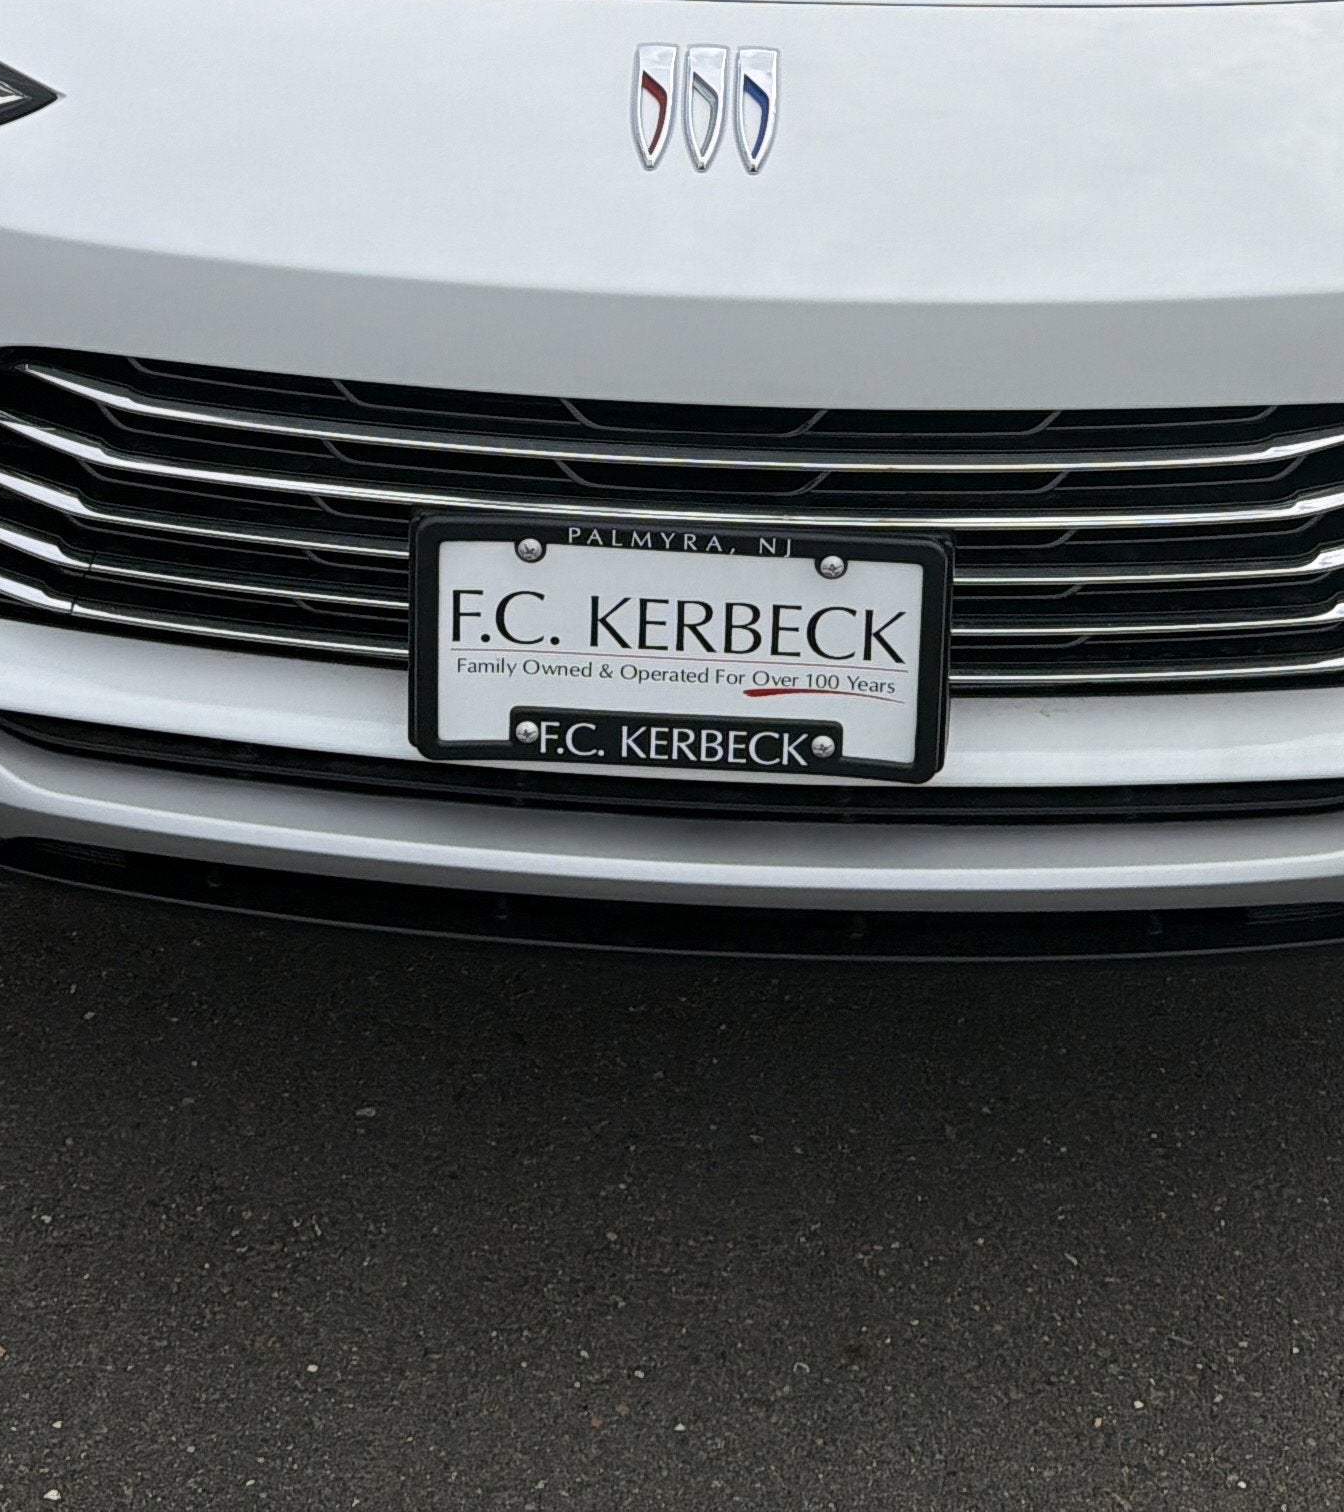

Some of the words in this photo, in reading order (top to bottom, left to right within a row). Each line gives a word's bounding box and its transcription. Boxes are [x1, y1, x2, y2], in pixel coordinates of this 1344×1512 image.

[567, 526, 736, 556] PALMYRA,
[758, 537, 794, 558] NJ
[451, 589, 561, 647] F.C.
[589, 594, 908, 665] KERBECK
[456, 657, 517, 678] Family
[522, 658, 593, 679] Owned
[598, 663, 614, 679] &
[620, 662, 709, 686] Operated
[715, 669, 744, 686] For
[752, 670, 799, 688] Over
[805, 673, 841, 691] 100
[846, 675, 897, 695] Years
[538, 721, 606, 757] F.C.
[620, 726, 809, 767] KERBECK
